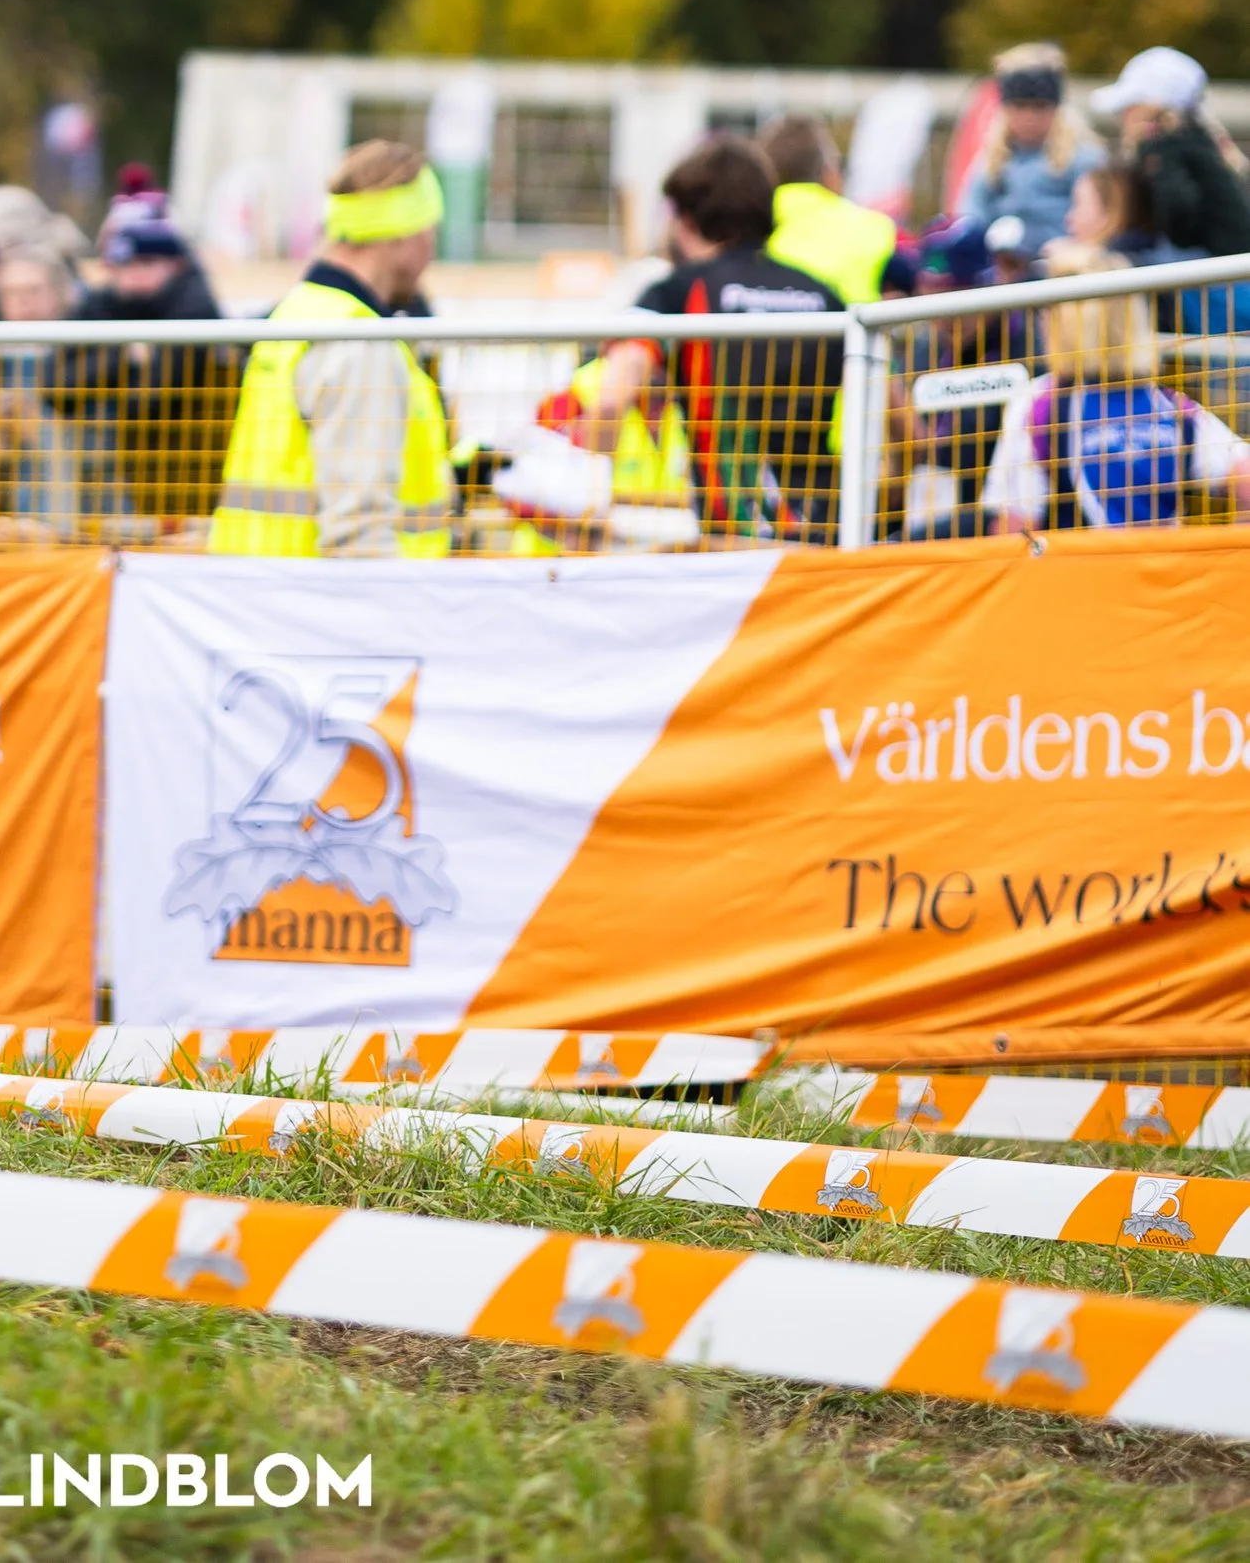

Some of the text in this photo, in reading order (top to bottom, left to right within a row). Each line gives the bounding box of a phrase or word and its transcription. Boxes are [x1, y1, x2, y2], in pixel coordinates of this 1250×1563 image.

[217, 668, 407, 829] 25
[819, 695, 1171, 783] Världens
[827, 854, 977, 934] The
[221, 905, 405, 954] manna
[831, 1152, 870, 1190] 25
[1137, 1179, 1181, 1220] 25
[1140, 1234, 1185, 1247] manna
